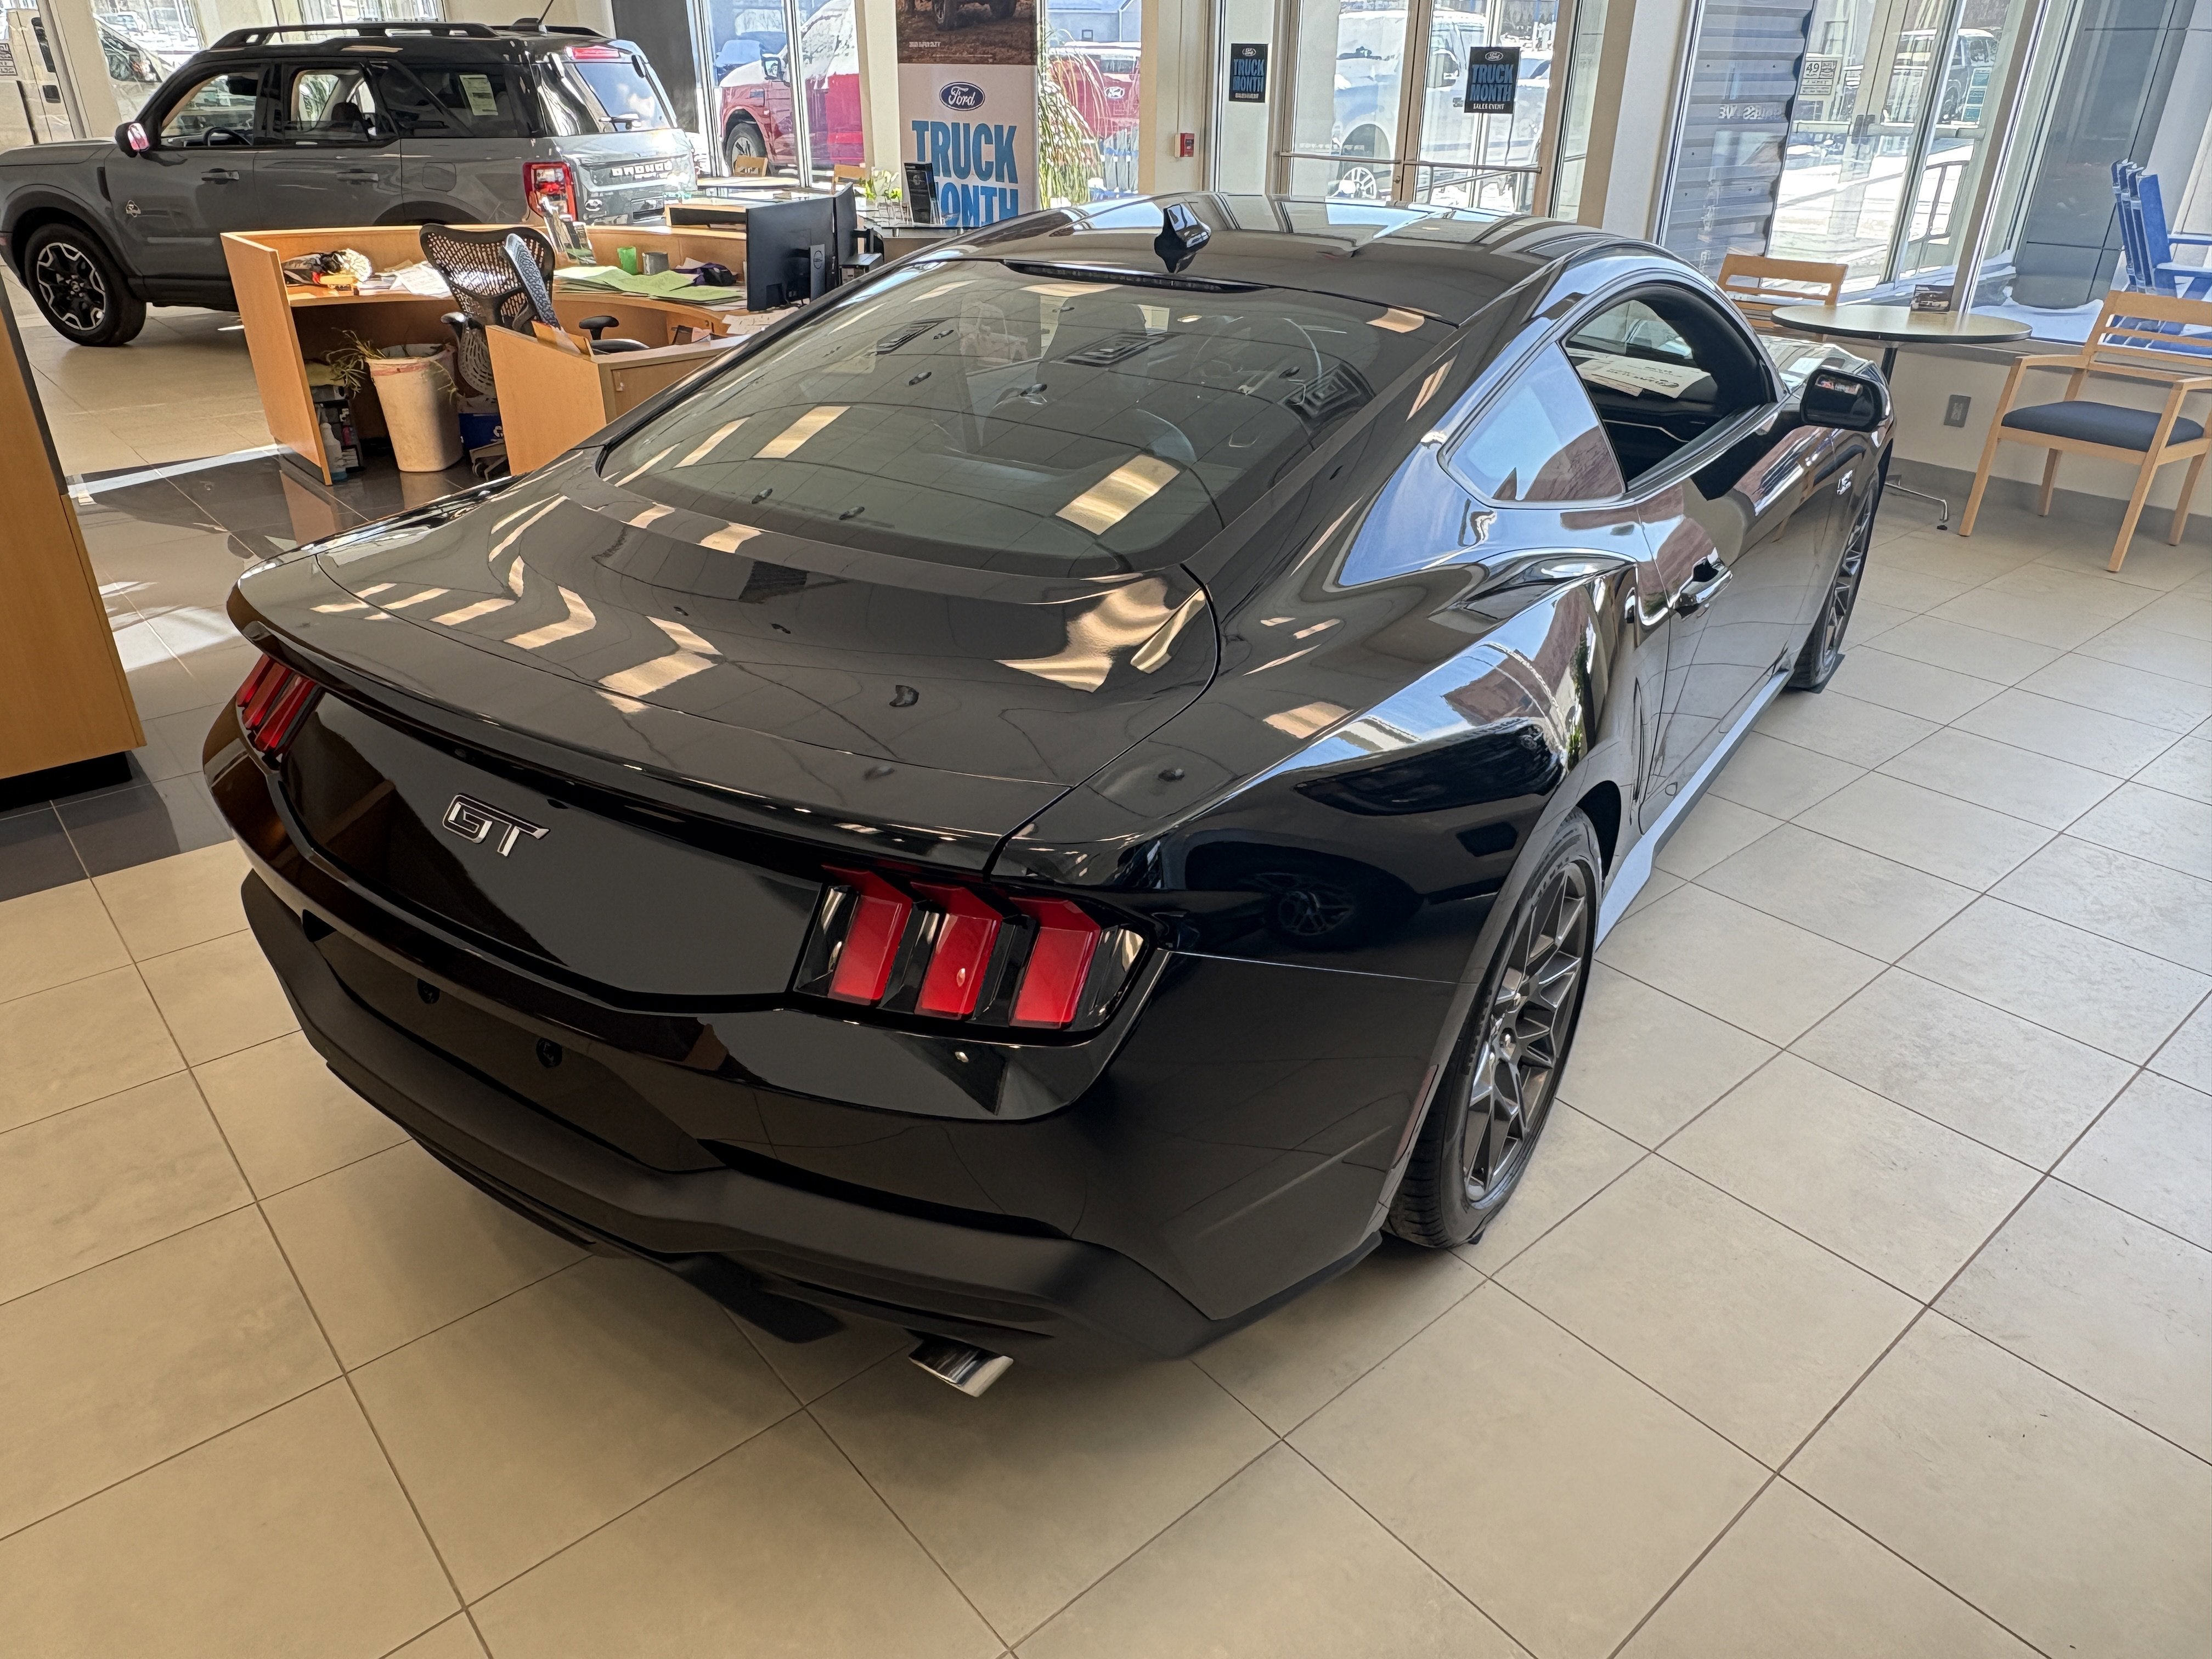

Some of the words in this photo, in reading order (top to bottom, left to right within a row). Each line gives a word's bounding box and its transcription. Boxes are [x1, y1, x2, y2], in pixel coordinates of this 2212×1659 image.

[1234, 59, 1265, 76] TRUCK
[1472, 64, 1514, 83] TRUCK
[1806, 63, 1820, 73] 49
[948, 86, 976, 106] Ford
[1470, 83, 1512, 101] MONTH
[912, 120, 1018, 184] TRUCK
[935, 182, 1019, 227] ONTH
[443, 793, 550, 857] GT
